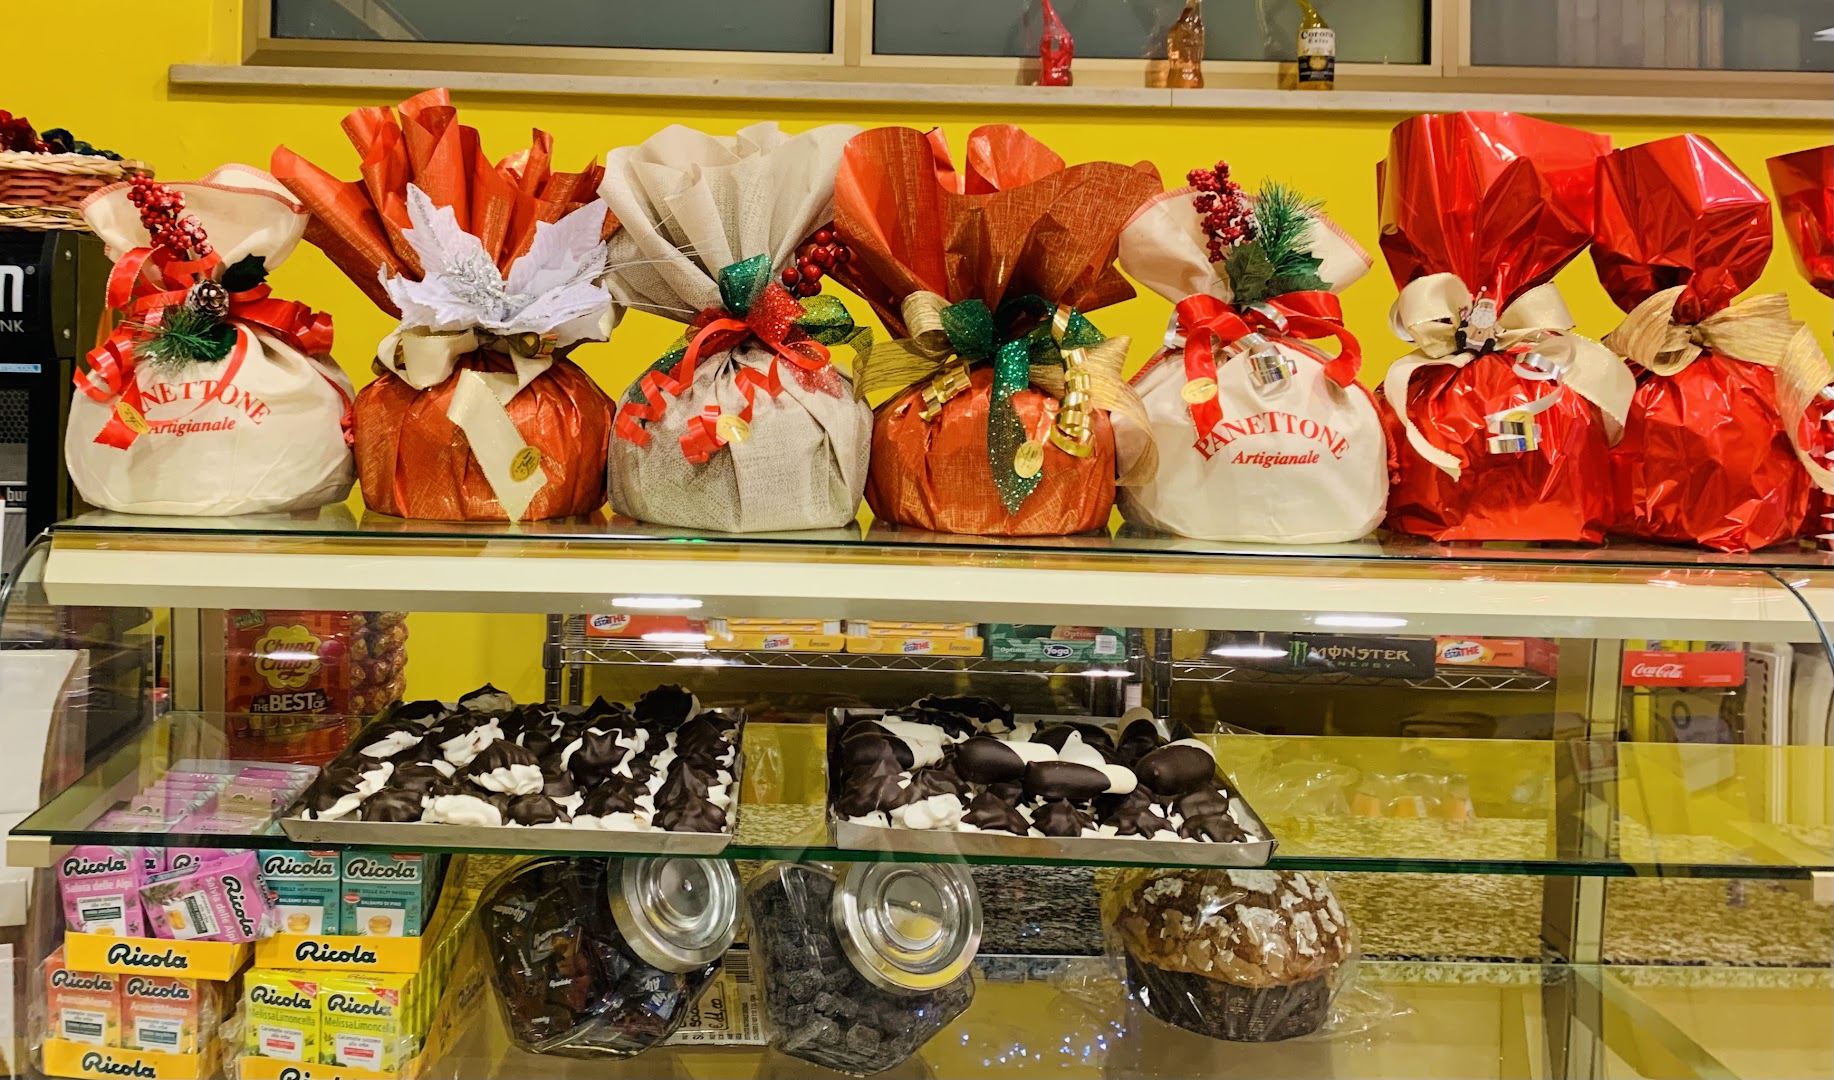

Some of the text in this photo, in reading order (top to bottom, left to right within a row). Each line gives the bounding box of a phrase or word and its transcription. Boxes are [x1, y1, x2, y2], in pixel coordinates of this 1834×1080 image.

[1301, 30, 1334, 39] Corona
[140, 380, 271, 426] NETTONE
[1192, 411, 1350, 462] PANETTONE
[1231, 450, 1320, 468] Artigianale
[1044, 644, 1070, 657] Yoga
[253, 692, 326, 712] THE BEST OF
[63, 856, 127, 876] Ricola
[264, 856, 333, 875] Ricola
[347, 859, 416, 878] Ricola
[222, 876, 254, 937] Ricola
[108, 943, 188, 968] Ricola
[296, 941, 377, 963] Ricola
[52, 970, 113, 991] Ricola
[127, 977, 190, 999] Ricola
[250, 986, 312, 1009] Ricola
[327, 994, 392, 1016] Ricola
[82, 1052, 156, 1079] Ricola
